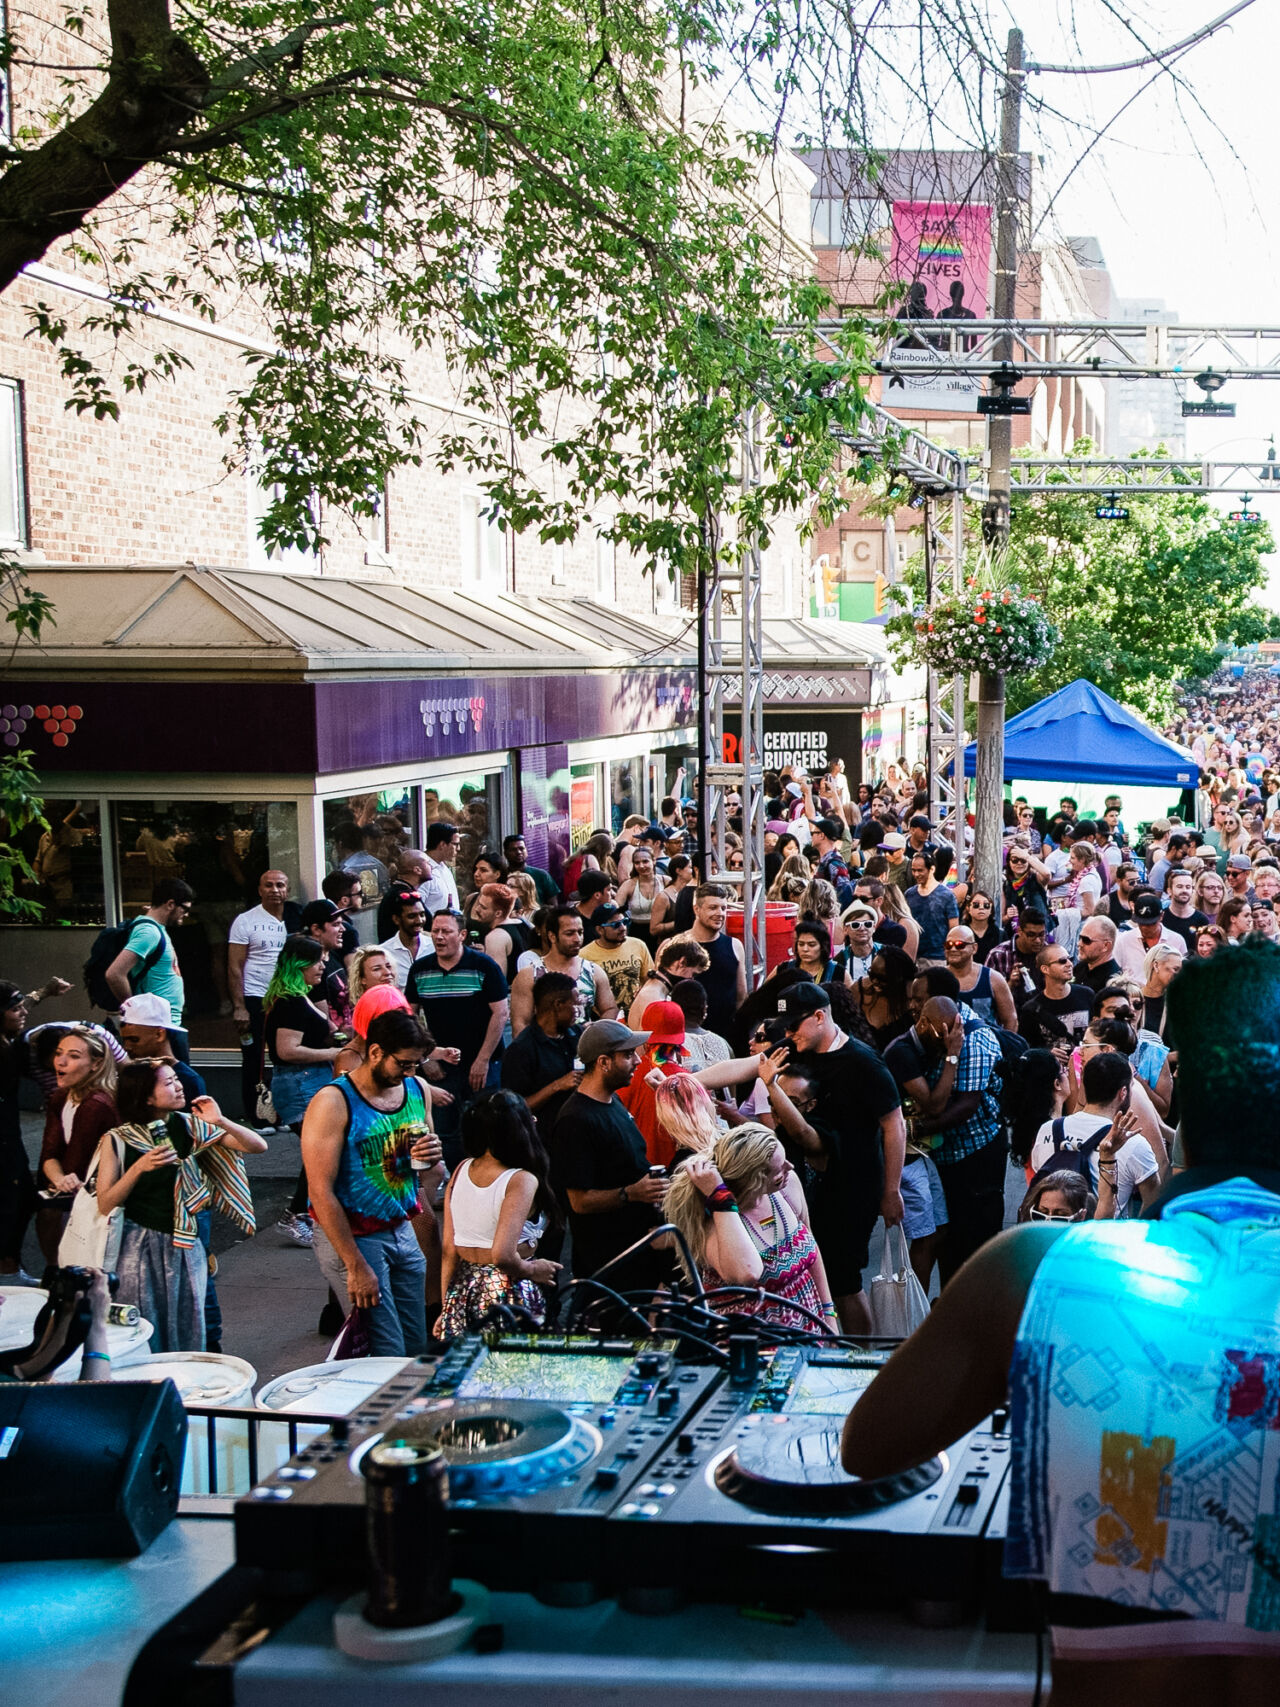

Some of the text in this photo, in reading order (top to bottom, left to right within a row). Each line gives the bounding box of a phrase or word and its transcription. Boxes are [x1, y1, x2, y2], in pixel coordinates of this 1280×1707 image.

[918, 262, 960, 277] LIVES
[763, 731, 828, 750] CERTIFIED
[763, 750, 828, 770] BURGERS
